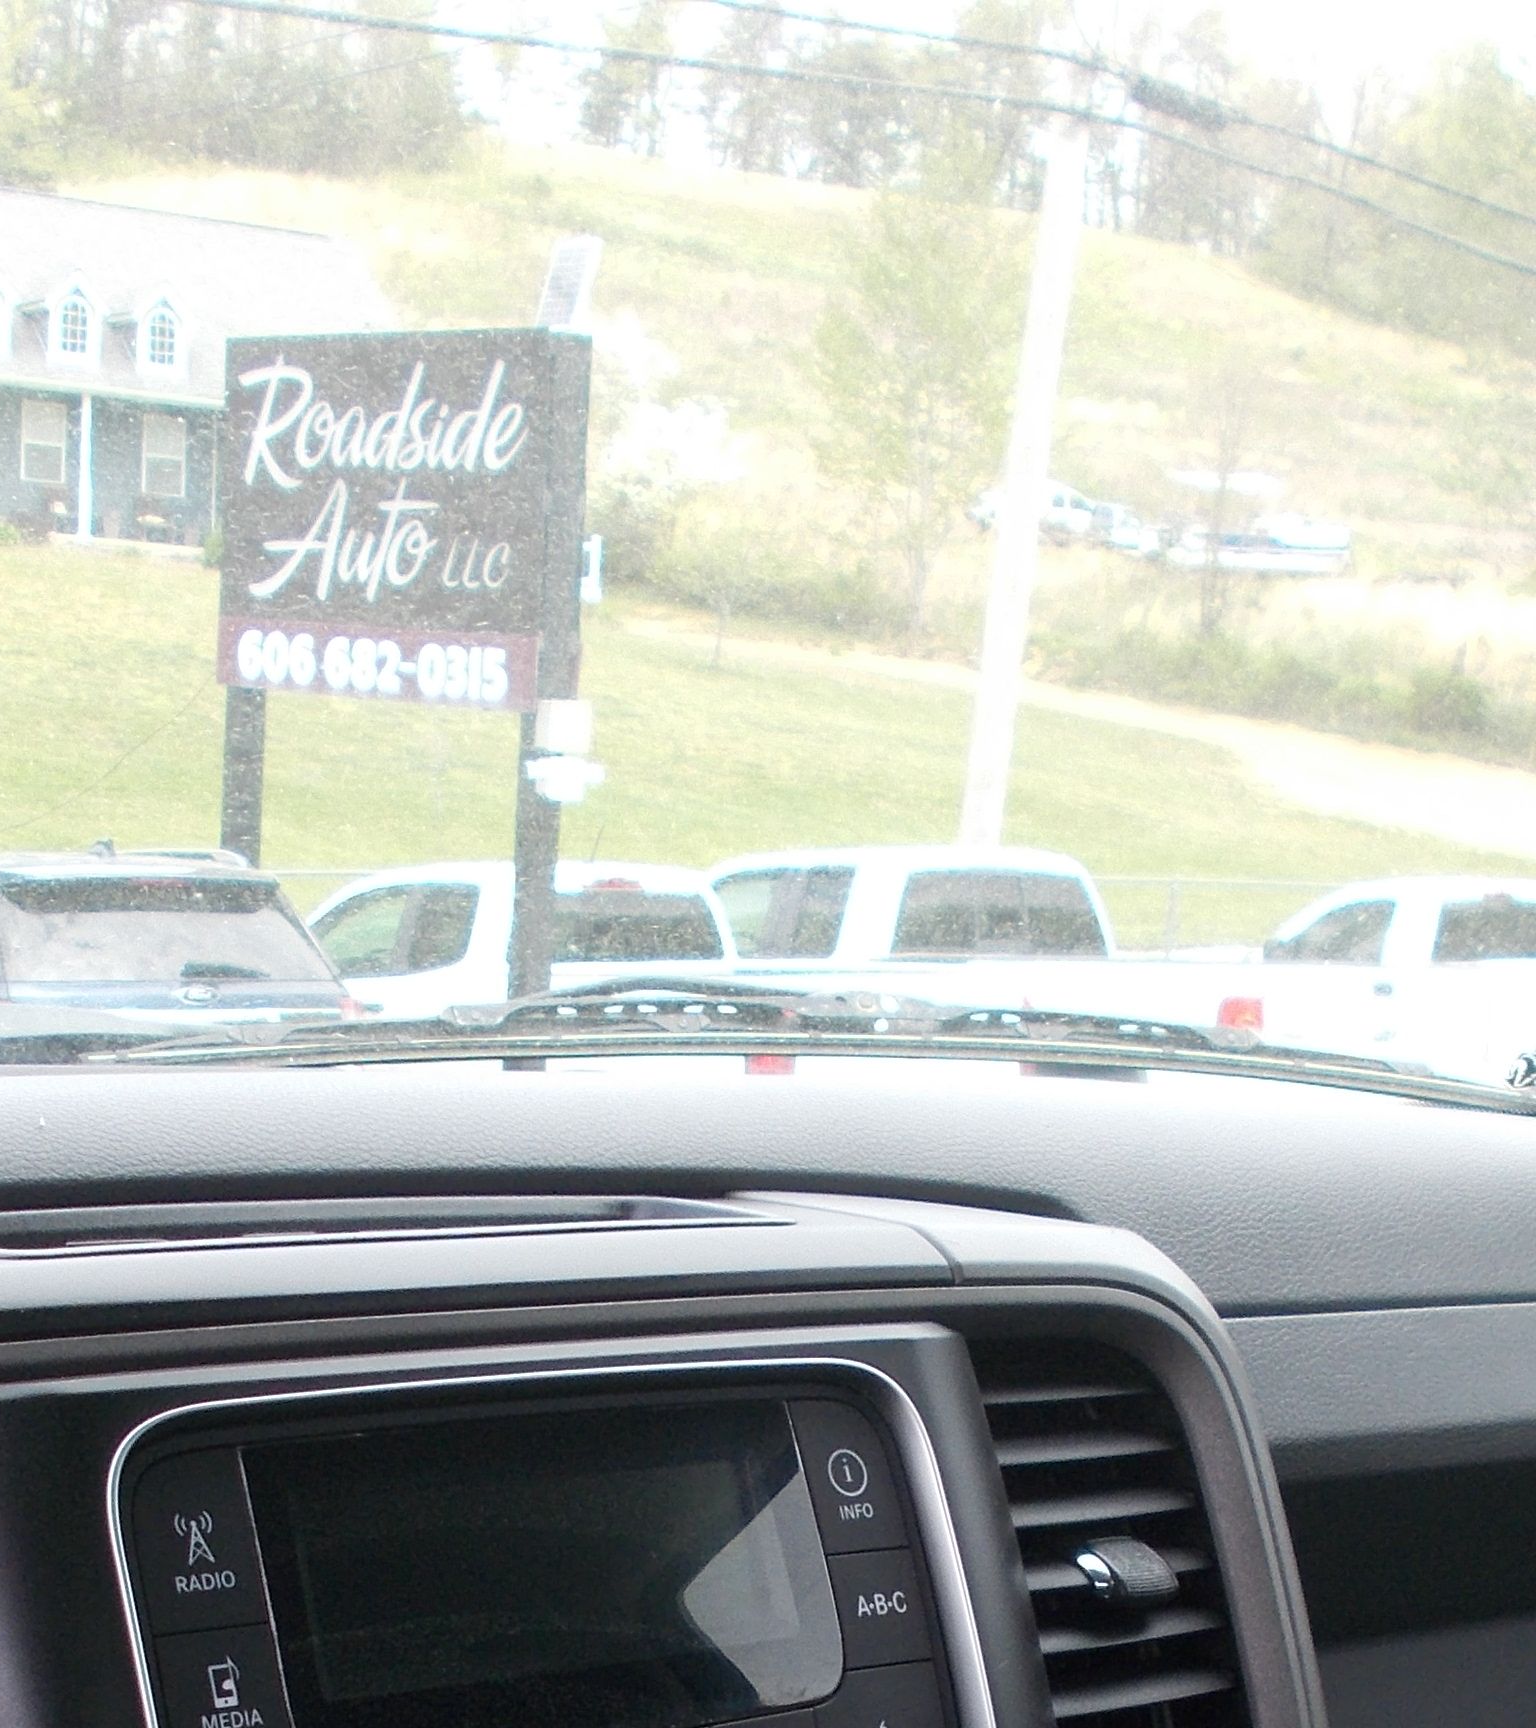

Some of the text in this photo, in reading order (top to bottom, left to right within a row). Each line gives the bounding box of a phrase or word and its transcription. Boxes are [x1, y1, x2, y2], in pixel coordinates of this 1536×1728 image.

[237, 353, 530, 489] Roadside
[249, 477, 511, 602] Auto LLC
[237, 629, 509, 703] 606 682-0315
[839, 1502, 874, 1521] INFO
[175, 1570, 236, 1593] RADIO
